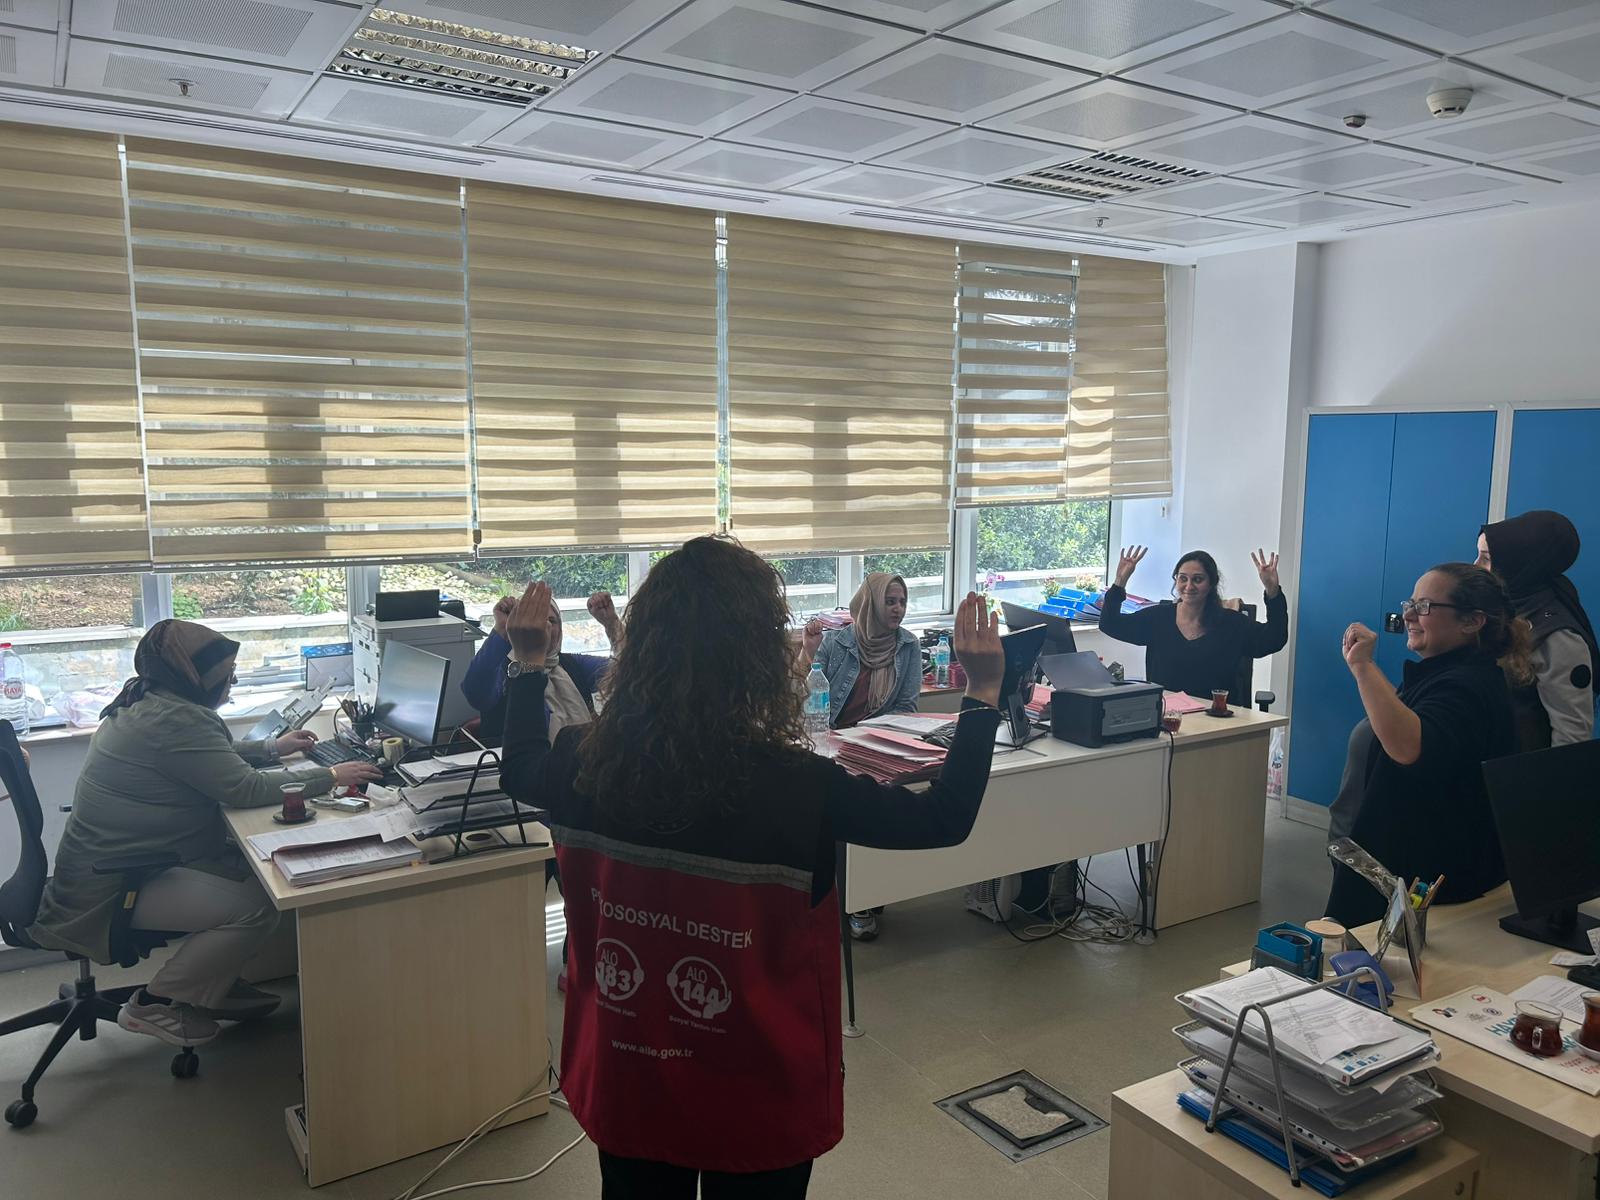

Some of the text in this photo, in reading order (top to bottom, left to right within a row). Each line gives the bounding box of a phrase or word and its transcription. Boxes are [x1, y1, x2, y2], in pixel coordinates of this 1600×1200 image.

[687, 921, 752, 948] DESTEK
[601, 949, 618, 967] ALO
[686, 965, 708, 984] ALO
[679, 979, 721, 1006] 144
